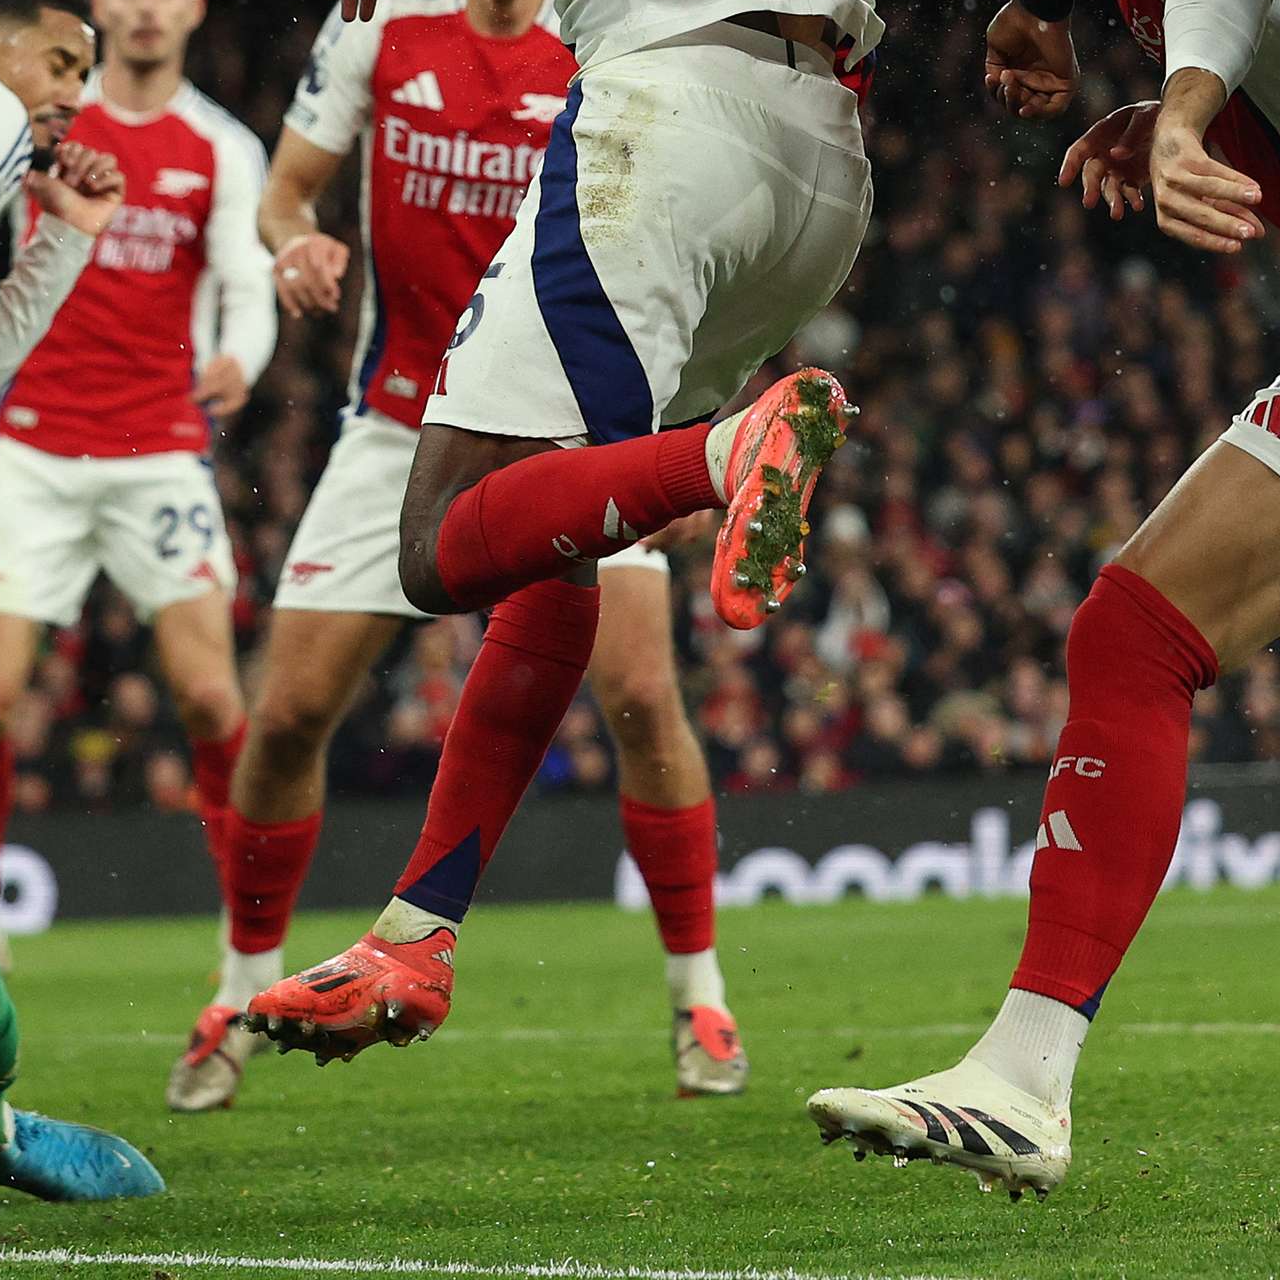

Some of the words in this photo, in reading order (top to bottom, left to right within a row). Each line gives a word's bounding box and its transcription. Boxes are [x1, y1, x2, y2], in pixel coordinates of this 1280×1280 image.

[383, 116, 547, 182] Emirat
[401, 170, 447, 210] FLY
[448, 179, 527, 219] BETT
[150, 504, 214, 560] 29
